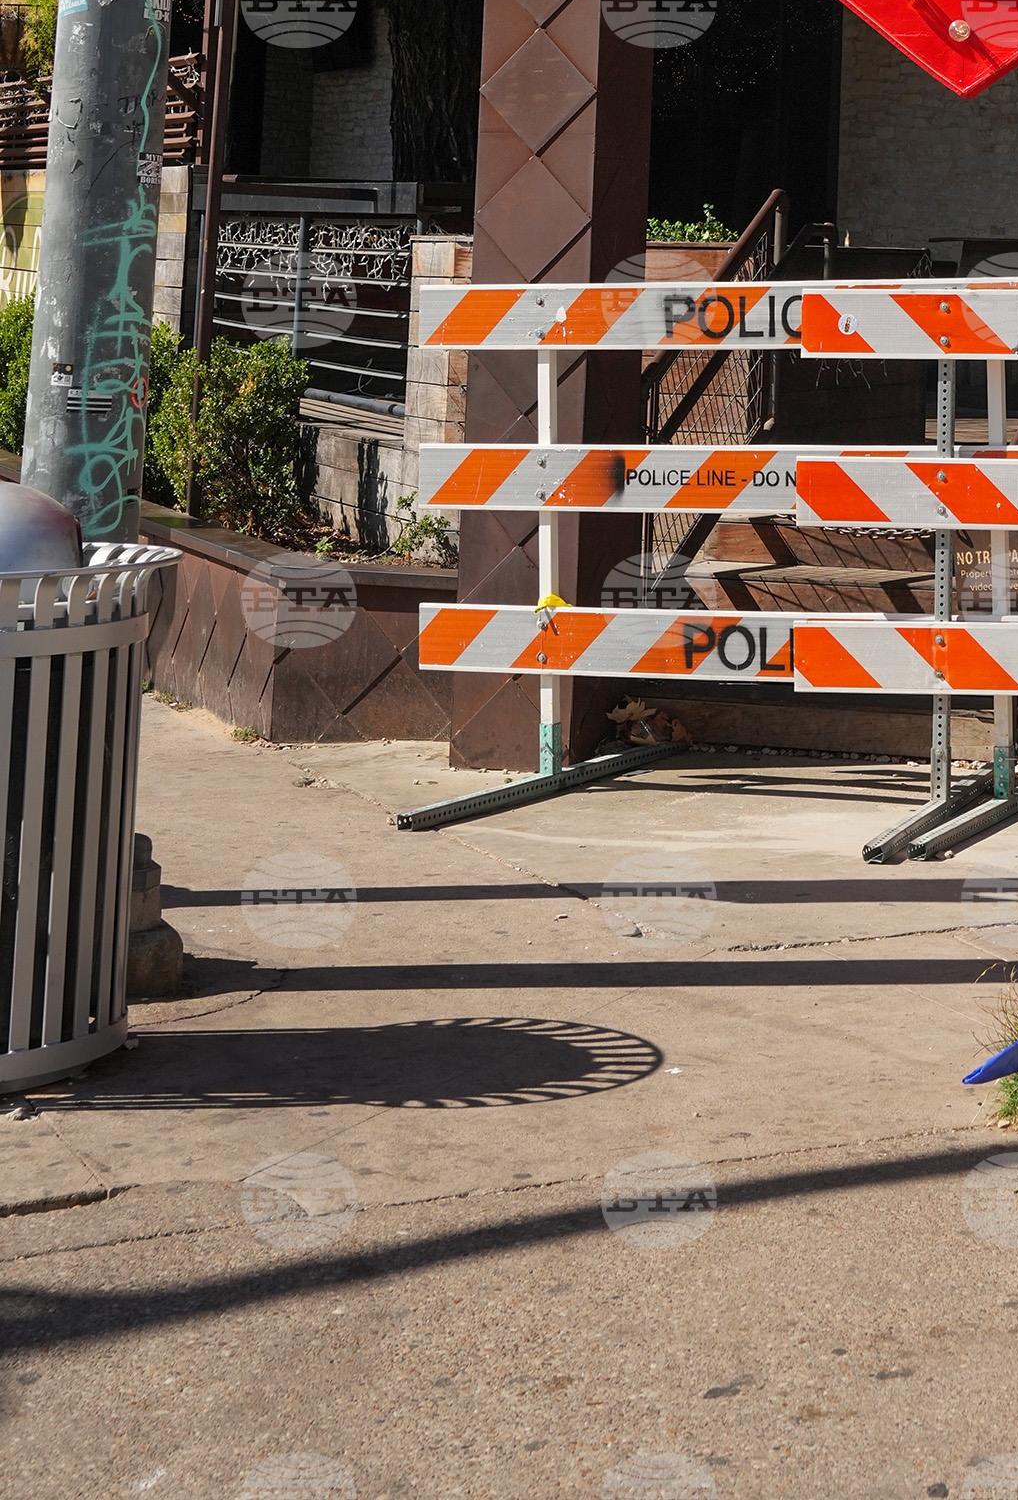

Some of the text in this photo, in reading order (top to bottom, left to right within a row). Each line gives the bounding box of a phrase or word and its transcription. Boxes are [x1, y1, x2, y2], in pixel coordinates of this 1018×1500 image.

[663, 294, 801, 339] POLIC
[626, 469, 691, 486] POLICE
[697, 470, 736, 486] LINE
[753, 470, 779, 487] DO
[956, 552, 973, 565] NO
[960, 570, 992, 580] Propert
[683, 622, 794, 671] POLI
